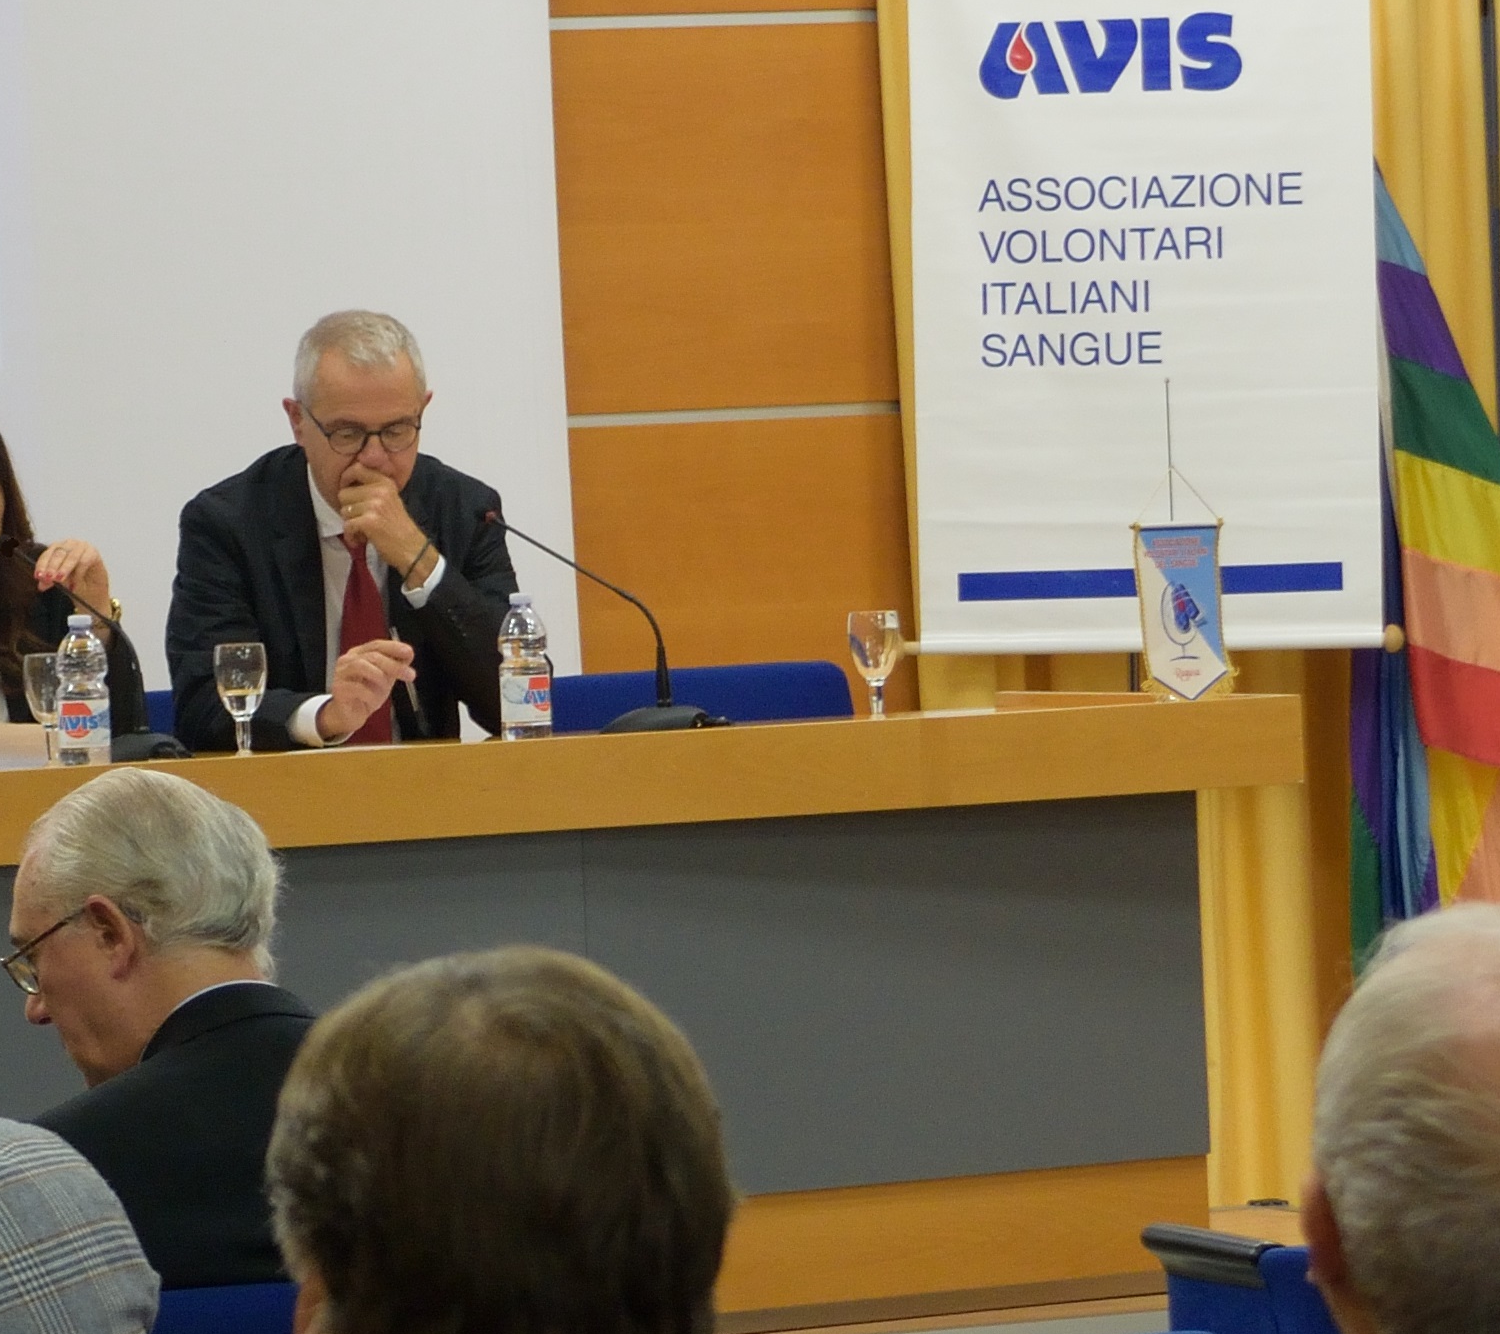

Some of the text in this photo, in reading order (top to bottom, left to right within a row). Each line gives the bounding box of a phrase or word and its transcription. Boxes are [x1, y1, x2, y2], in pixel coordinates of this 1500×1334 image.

[979, 12, 1242, 99] AVIS
[978, 172, 1303, 212] ASSOCIAZIONE
[979, 226, 1223, 264] VOLONTARI
[981, 280, 1150, 316] ITALIANI
[981, 331, 1163, 368] SANGUE
